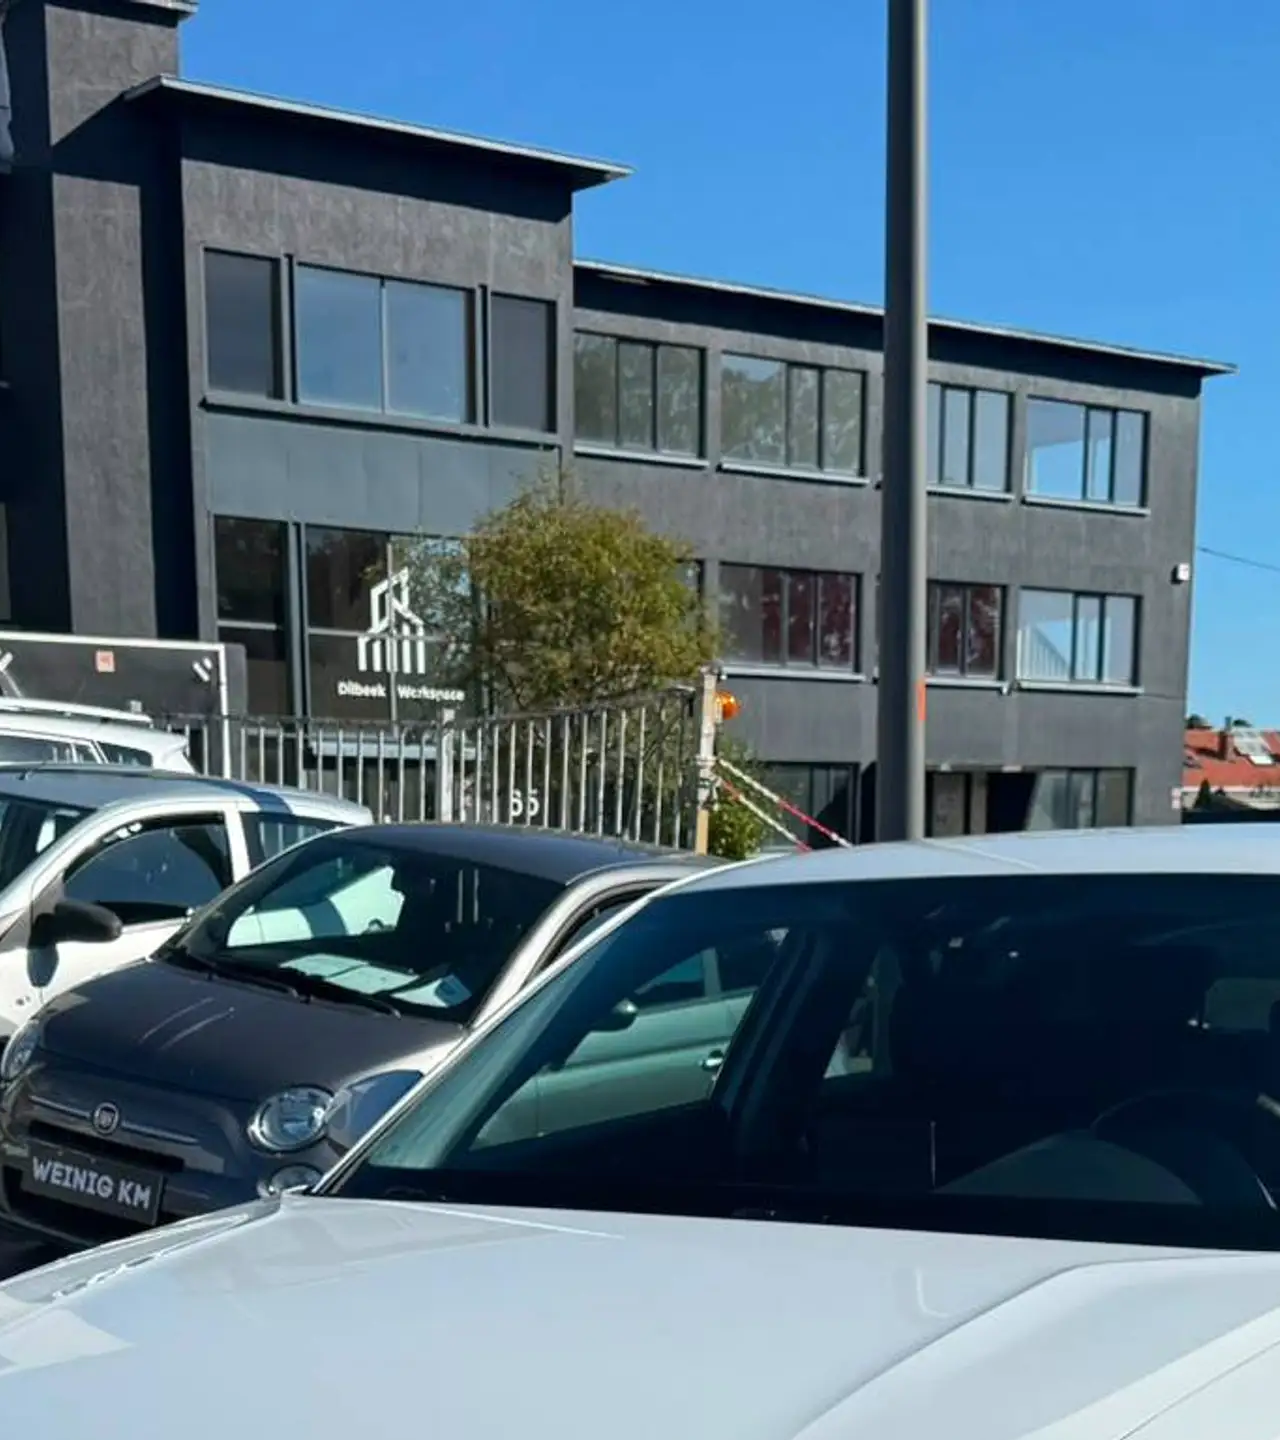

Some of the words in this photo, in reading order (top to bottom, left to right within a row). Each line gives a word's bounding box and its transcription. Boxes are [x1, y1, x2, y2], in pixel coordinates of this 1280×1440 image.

[397, 683, 465, 702] Workspace
[32, 1155, 115, 1199] WEINIG
[118, 1178, 152, 1211] KM
